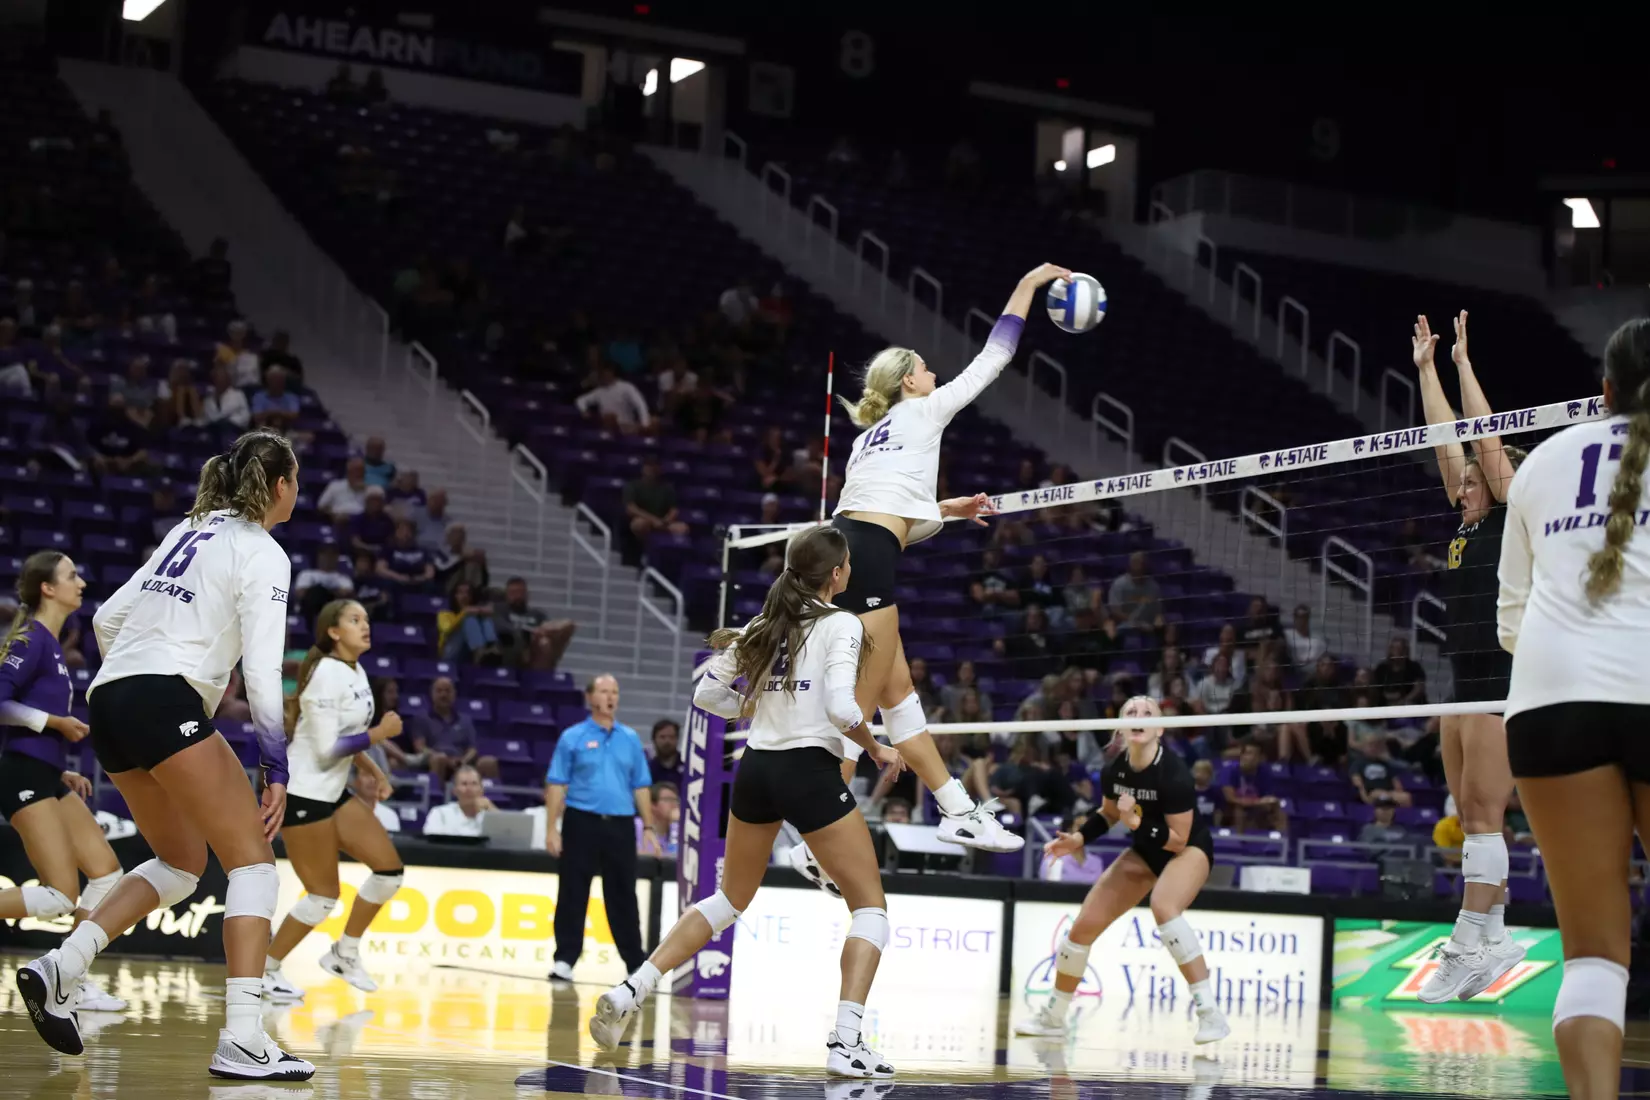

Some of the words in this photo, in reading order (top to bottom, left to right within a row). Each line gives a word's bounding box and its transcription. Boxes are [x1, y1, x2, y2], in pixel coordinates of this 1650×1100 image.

[263, 11, 436, 66] AHEARN
[841, 30, 874, 78] 8
[1473, 409, 1537, 435] K-STATE
[1369, 428, 1428, 452] K-STATE
[1274, 444, 1328, 467] K-STATE
[1187, 460, 1236, 481] K-STATE
[1033, 486, 1075, 504] K-STATE
[1107, 474, 1152, 493] K-STATE
[154, 530, 215, 578] 15
[680, 710, 709, 914] -STATE
[368, 939, 516, 962] MEXICAN
[535, 947, 609, 964] ETS
[1121, 964, 1177, 1002] Via
[1205, 966, 1305, 1003] hristi
